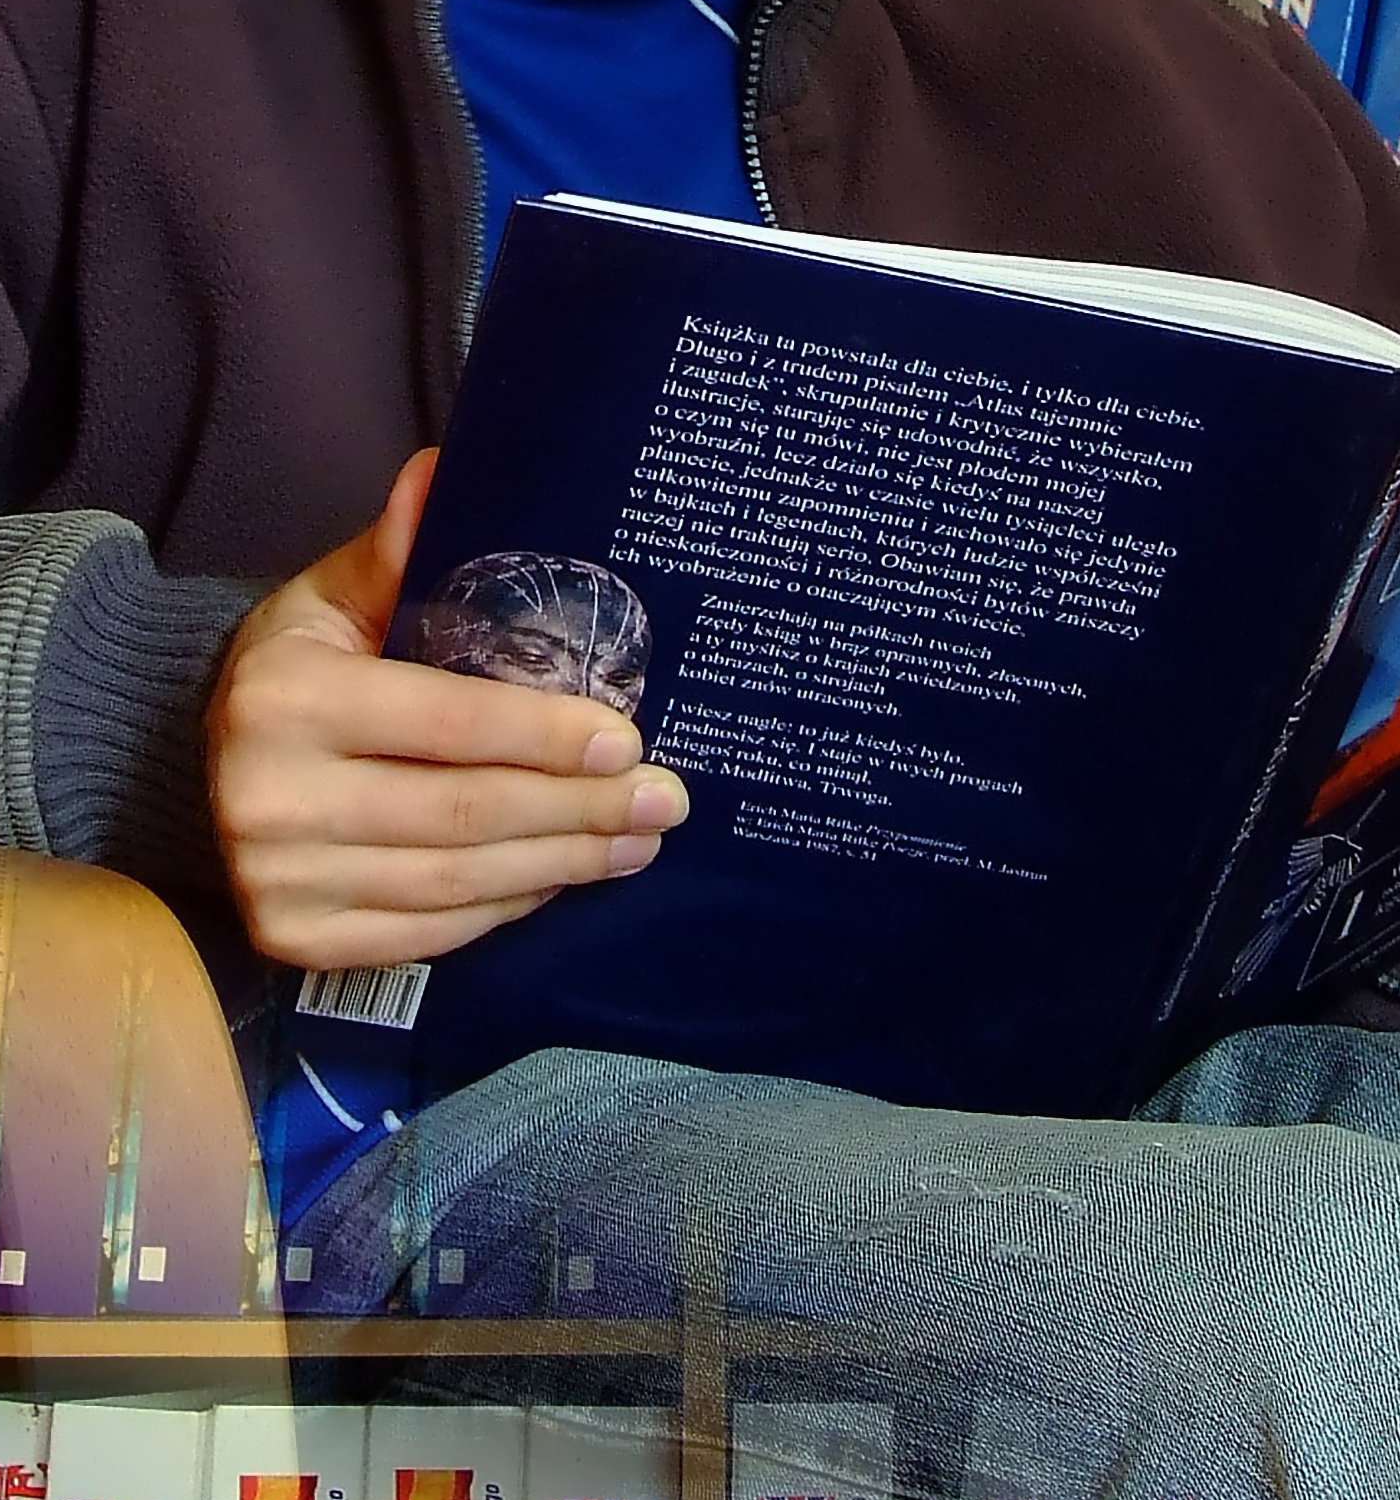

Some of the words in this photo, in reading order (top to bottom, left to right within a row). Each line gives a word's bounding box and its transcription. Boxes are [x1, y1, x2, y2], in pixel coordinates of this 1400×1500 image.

[675, 338, 744, 365] Długo
[782, 358, 858, 388] trudem
[864, 372, 948, 404] pisałem
[1029, 405, 1122, 438] tajemnic
[682, 315, 770, 348] Książka
[800, 340, 898, 372] powstała
[904, 358, 938, 379] dla
[1035, 385, 1091, 415] tylko
[1096, 396, 1129, 415] dla
[678, 662, 736, 686] kobiet
[740, 677, 792, 697] znów
[796, 687, 902, 717] utraconych.
